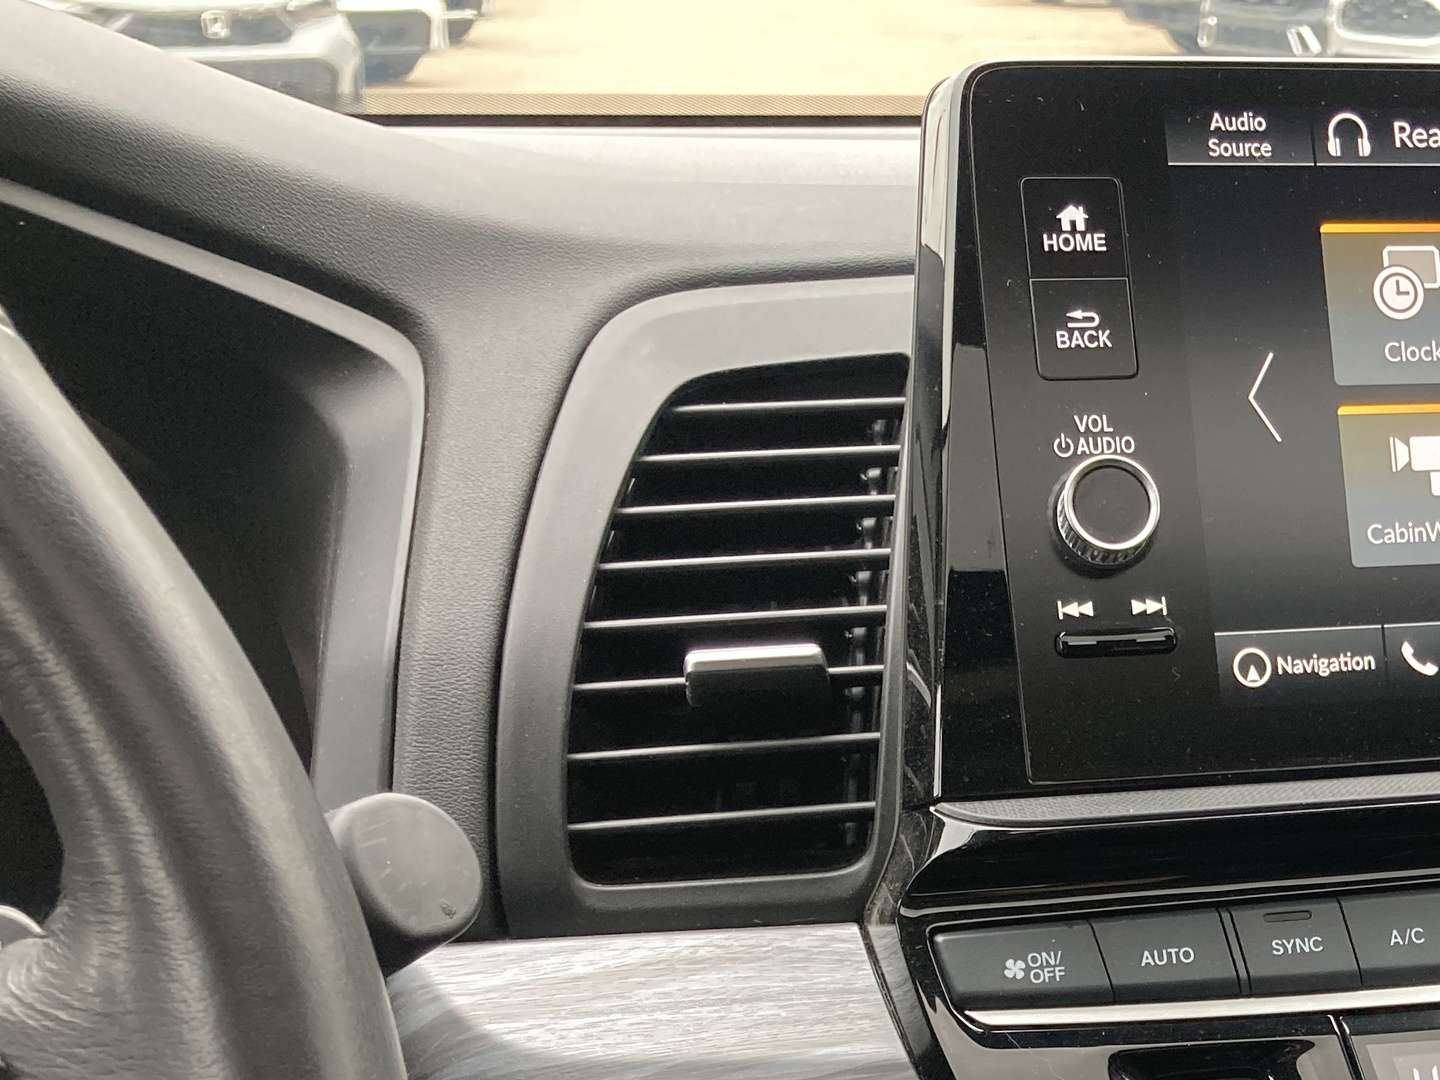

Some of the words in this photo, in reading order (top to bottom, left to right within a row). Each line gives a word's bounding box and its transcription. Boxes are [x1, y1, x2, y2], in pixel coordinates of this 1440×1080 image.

[1210, 112, 1266, 132] Audio
[1208, 138, 1272, 158] Source
[1043, 232, 1107, 252] HOME
[1056, 330, 1113, 349] BACK
[1074, 415, 1113, 433] VOL
[1077, 436, 1135, 454] AUDIO
[1277, 652, 1375, 677] Navigation
[1390, 927, 1425, 945] A/C
[1271, 936, 1324, 956] SYNC
[1028, 950, 1061, 967] ON/
[1141, 947, 1195, 966] AUTO
[1030, 966, 1065, 984] OFF
